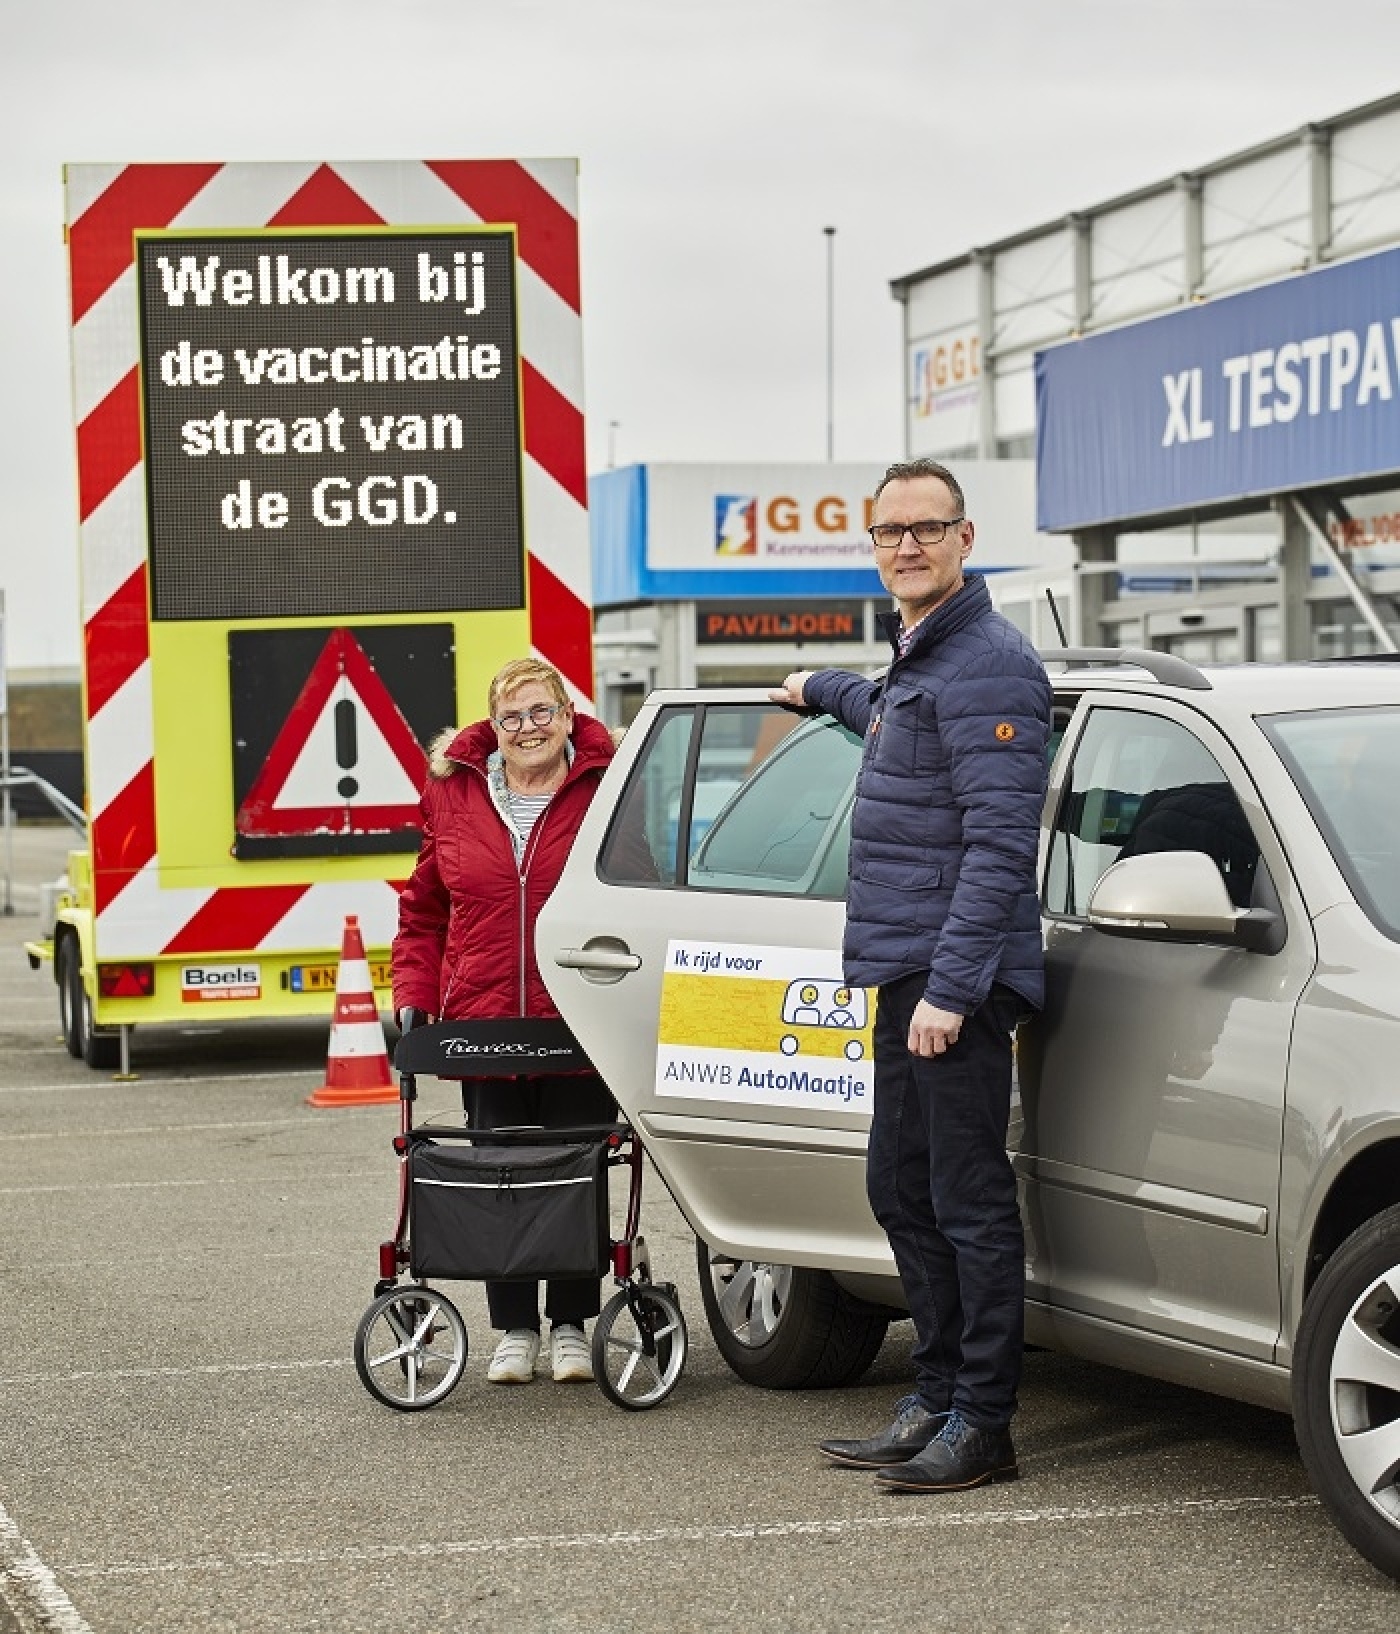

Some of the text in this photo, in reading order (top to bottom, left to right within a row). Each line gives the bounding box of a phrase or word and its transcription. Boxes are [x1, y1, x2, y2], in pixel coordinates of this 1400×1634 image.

[156, 252, 486, 315] Welkom bij
[159, 336, 501, 386] de vaccinatie
[1161, 367, 1214, 447] XL
[182, 408, 463, 456] straat van
[221, 476, 457, 530] de GGD.
[707, 613, 853, 636] PAVILJOEN
[185, 967, 257, 985] Boels
[674, 949, 763, 973] Ik rijd voor
[664, 1061, 865, 1102] ANWB AutoMaatje
